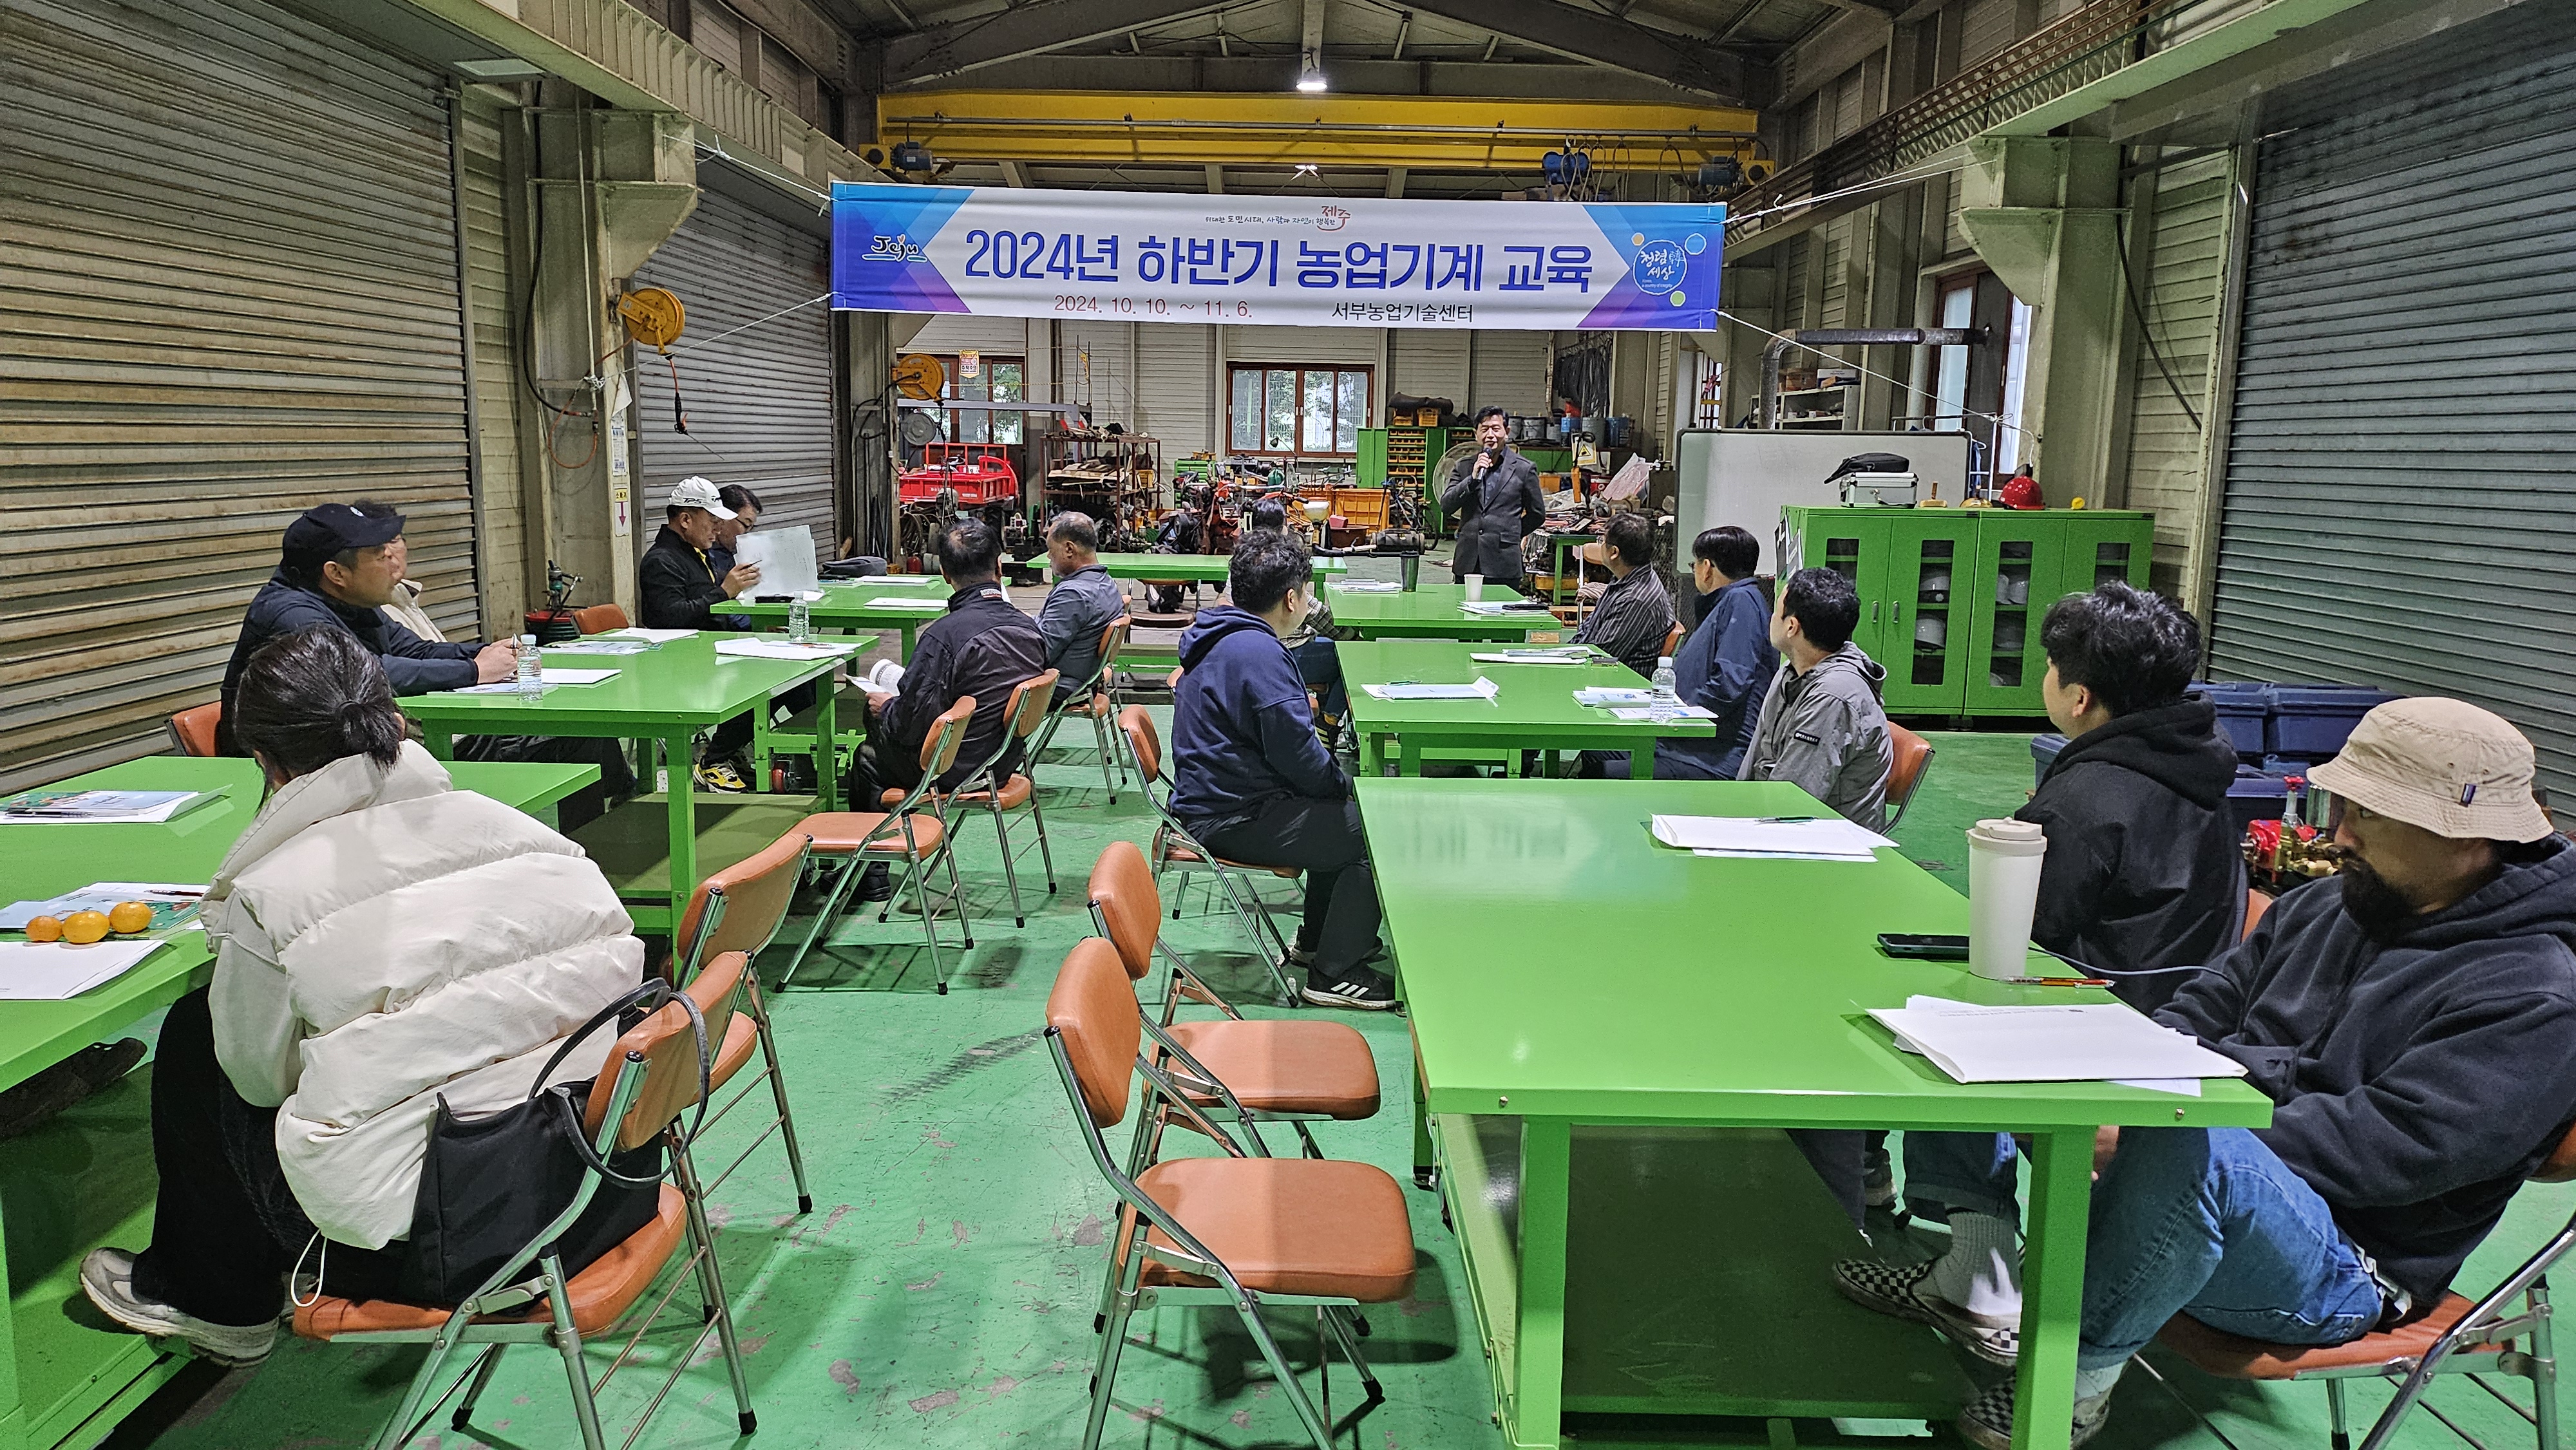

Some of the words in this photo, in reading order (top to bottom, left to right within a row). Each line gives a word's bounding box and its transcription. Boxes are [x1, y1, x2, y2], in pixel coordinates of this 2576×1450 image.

[1227, 215, 1264, 224] 도민시대,
[1266, 216, 1290, 225] 사람과
[1316, 217, 1336, 226] 행복한
[1319, 205, 1351, 230] 제주
[871, 234, 919, 261] Jeju
[965, 230, 1119, 283] 2024년
[1138, 236, 1278, 287] 하반기
[1296, 241, 1484, 292] 농업기계
[1499, 246, 1593, 294] 교육
[1647, 265, 1675, 280] 세상
[1055, 295, 1103, 312] 2024.
[1112, 297, 1137, 314] 10.
[1146, 298, 1170, 315] 10.
[1204, 300, 1229, 316] 11.
[1237, 301, 1253, 317] 6.
[1331, 302, 1473, 323] 서부농업기술센터
